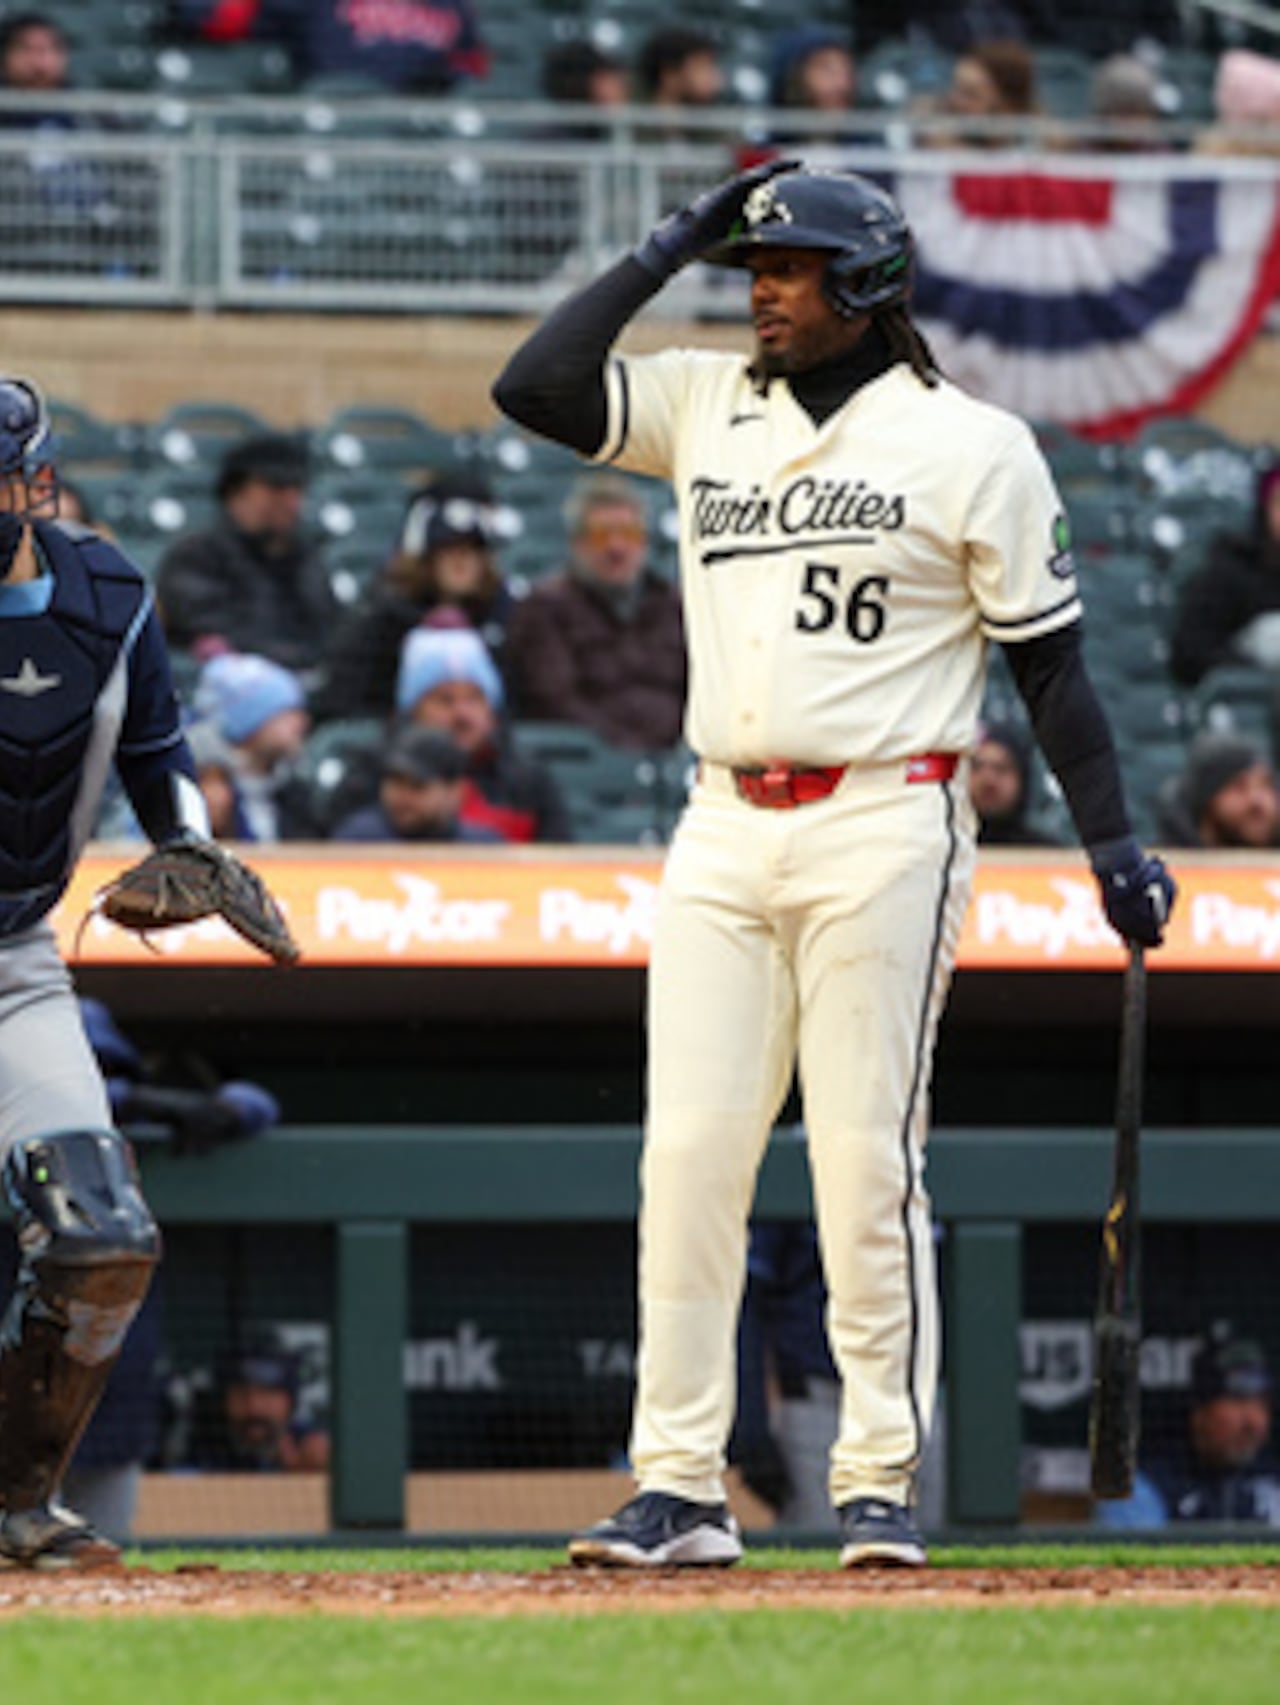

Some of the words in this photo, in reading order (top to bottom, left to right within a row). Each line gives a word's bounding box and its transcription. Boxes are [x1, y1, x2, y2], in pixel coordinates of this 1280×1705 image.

[690, 475, 771, 539] Twin
[778, 475, 905, 534] Cities
[795, 562, 889, 644] 56
[317, 870, 510, 953] Paycor
